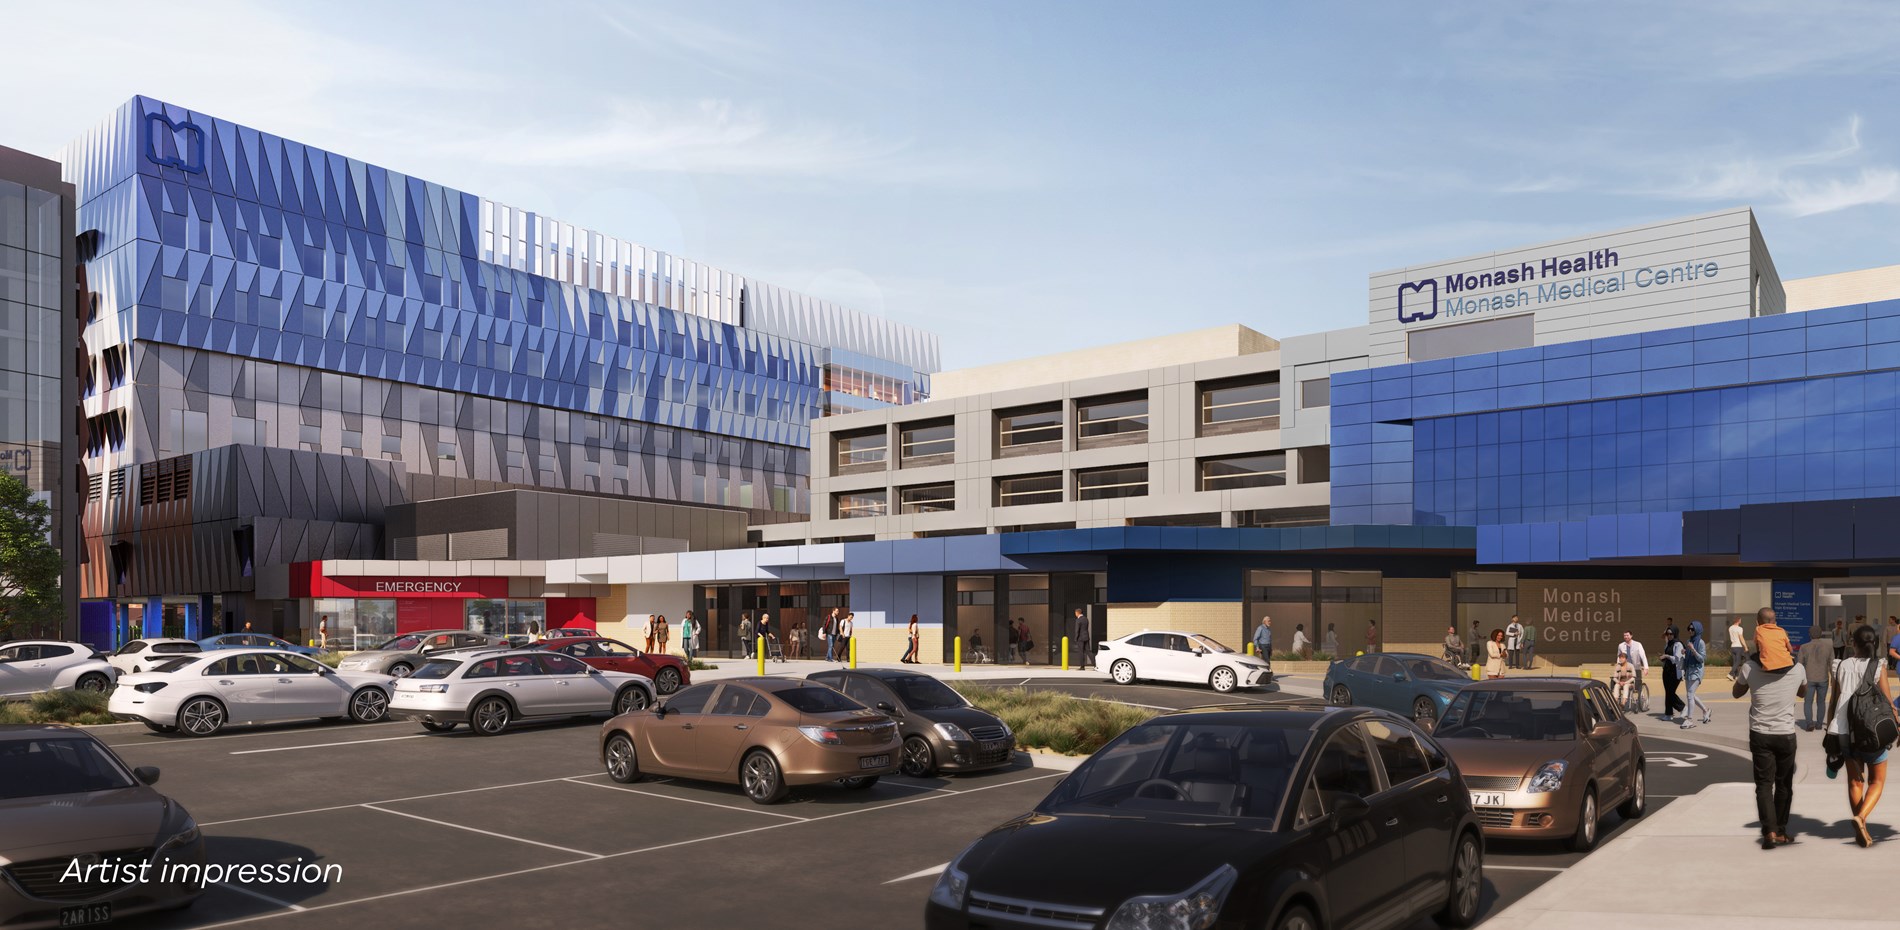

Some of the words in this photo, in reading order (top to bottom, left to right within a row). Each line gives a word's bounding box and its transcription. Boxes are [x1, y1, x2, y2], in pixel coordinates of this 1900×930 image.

[1445, 263, 1534, 293] Monash
[1541, 248, 1619, 279] Health
[1445, 284, 1529, 317] Monash
[1537, 276, 1626, 304] Medical
[1635, 260, 1718, 287] Centre
[375, 581, 462, 593] EMERGENCY
[1543, 588, 1621, 604] Monash
[1543, 607, 1622, 623] Medical
[1543, 626, 1611, 642] Centre
